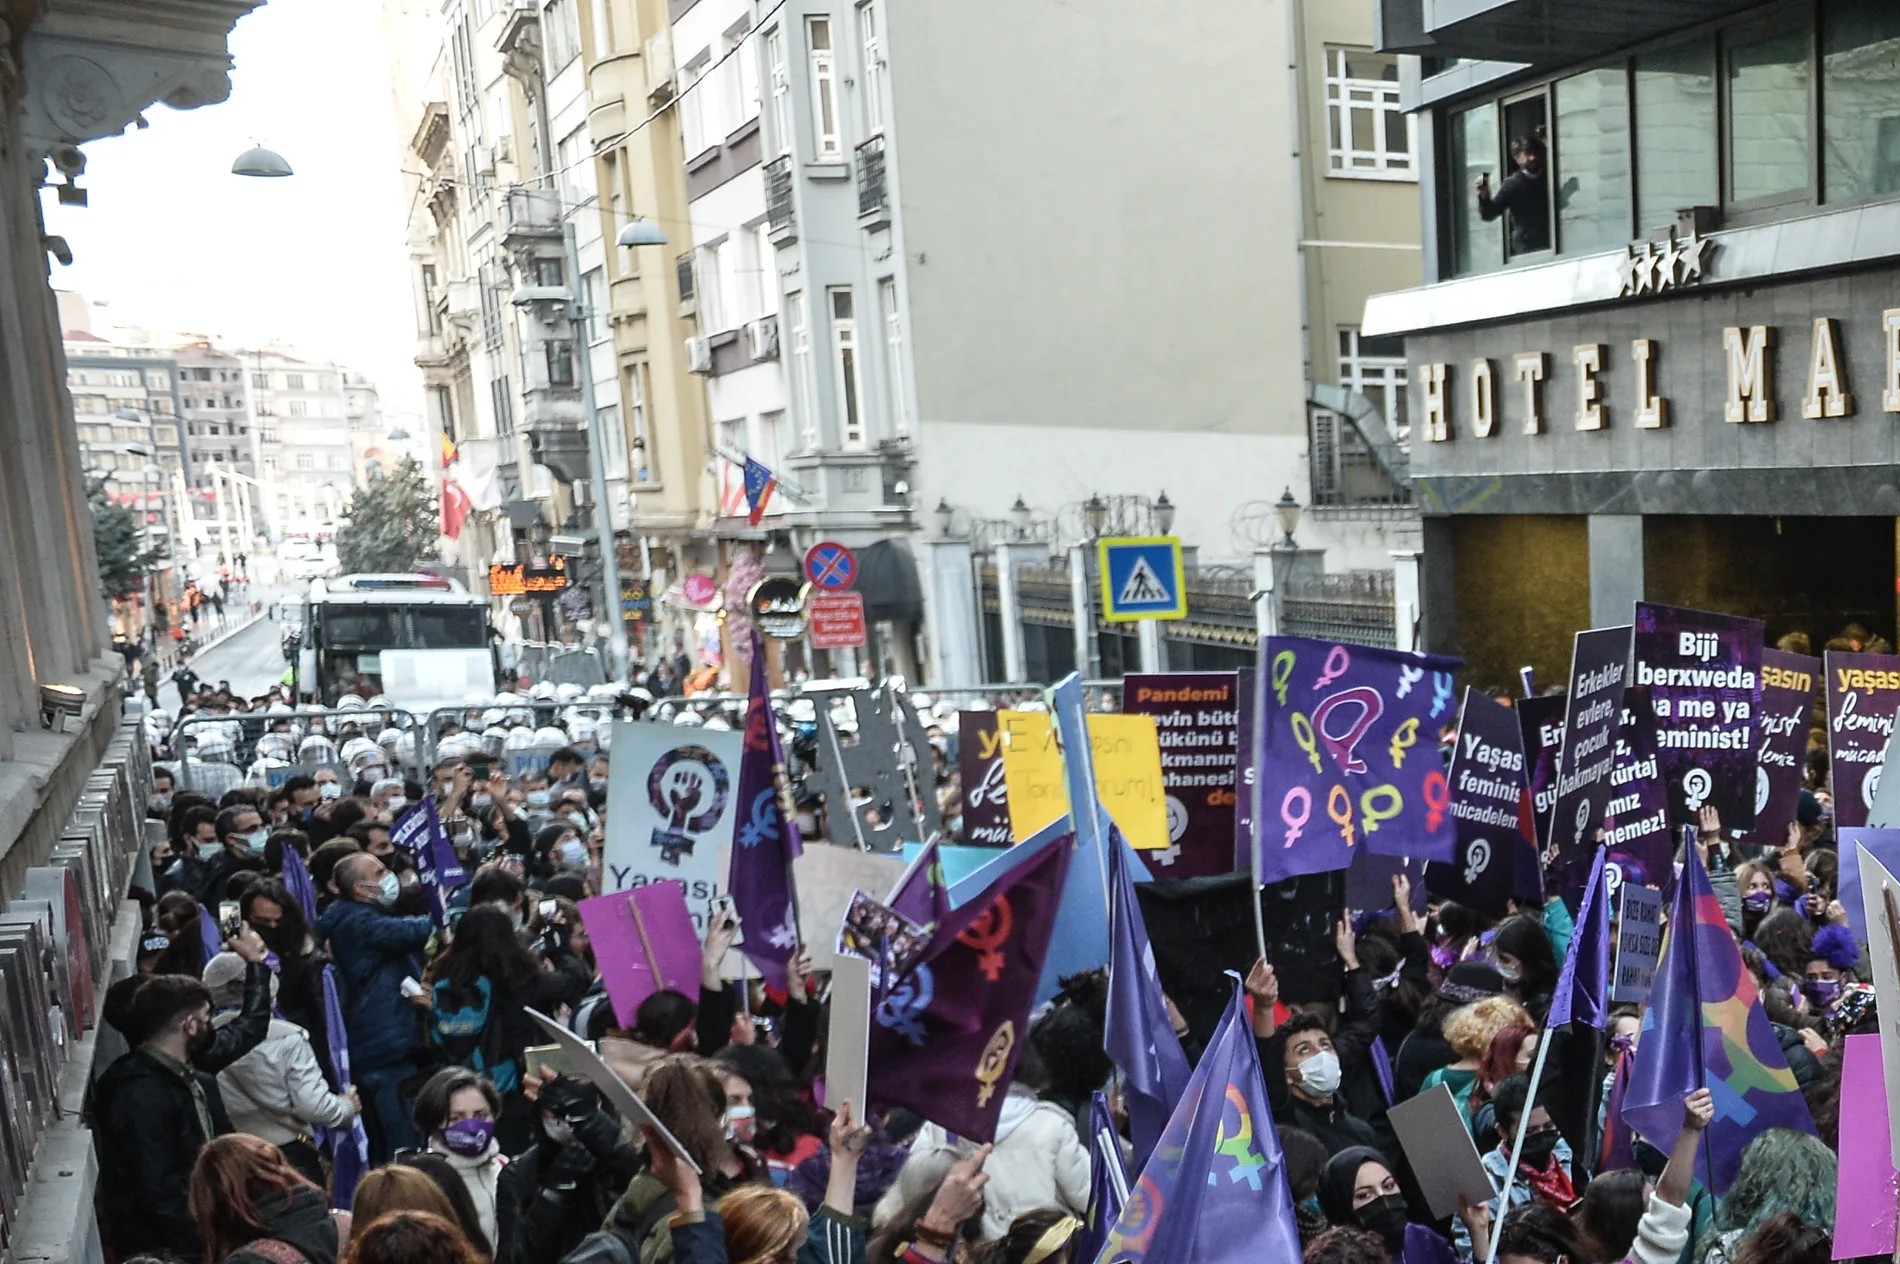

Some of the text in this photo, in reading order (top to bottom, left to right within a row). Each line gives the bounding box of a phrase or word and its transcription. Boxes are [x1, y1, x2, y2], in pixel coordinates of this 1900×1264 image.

[1418, 338, 1667, 443] HOTEL
[1678, 631, 1720, 663] Bijî
[1575, 663, 1625, 701] Erkekler
[1637, 661, 1756, 690] berxweda
[1760, 665, 1812, 692] şasın
[1137, 686, 1229, 703] Pandemi
[1576, 698, 1614, 730] evlere,
[1678, 700, 1715, 719] me
[1722, 701, 1750, 724] ya
[1833, 691, 1895, 736] femini
[1158, 731, 1224, 750] ükünü
[1464, 733, 1523, 773] Yaşas
[1574, 725, 1611, 767] çocuk
[1656, 724, 1750, 750] emînîst!
[1459, 769, 1521, 804] feminis
[1559, 749, 1615, 797] bakmaya!
